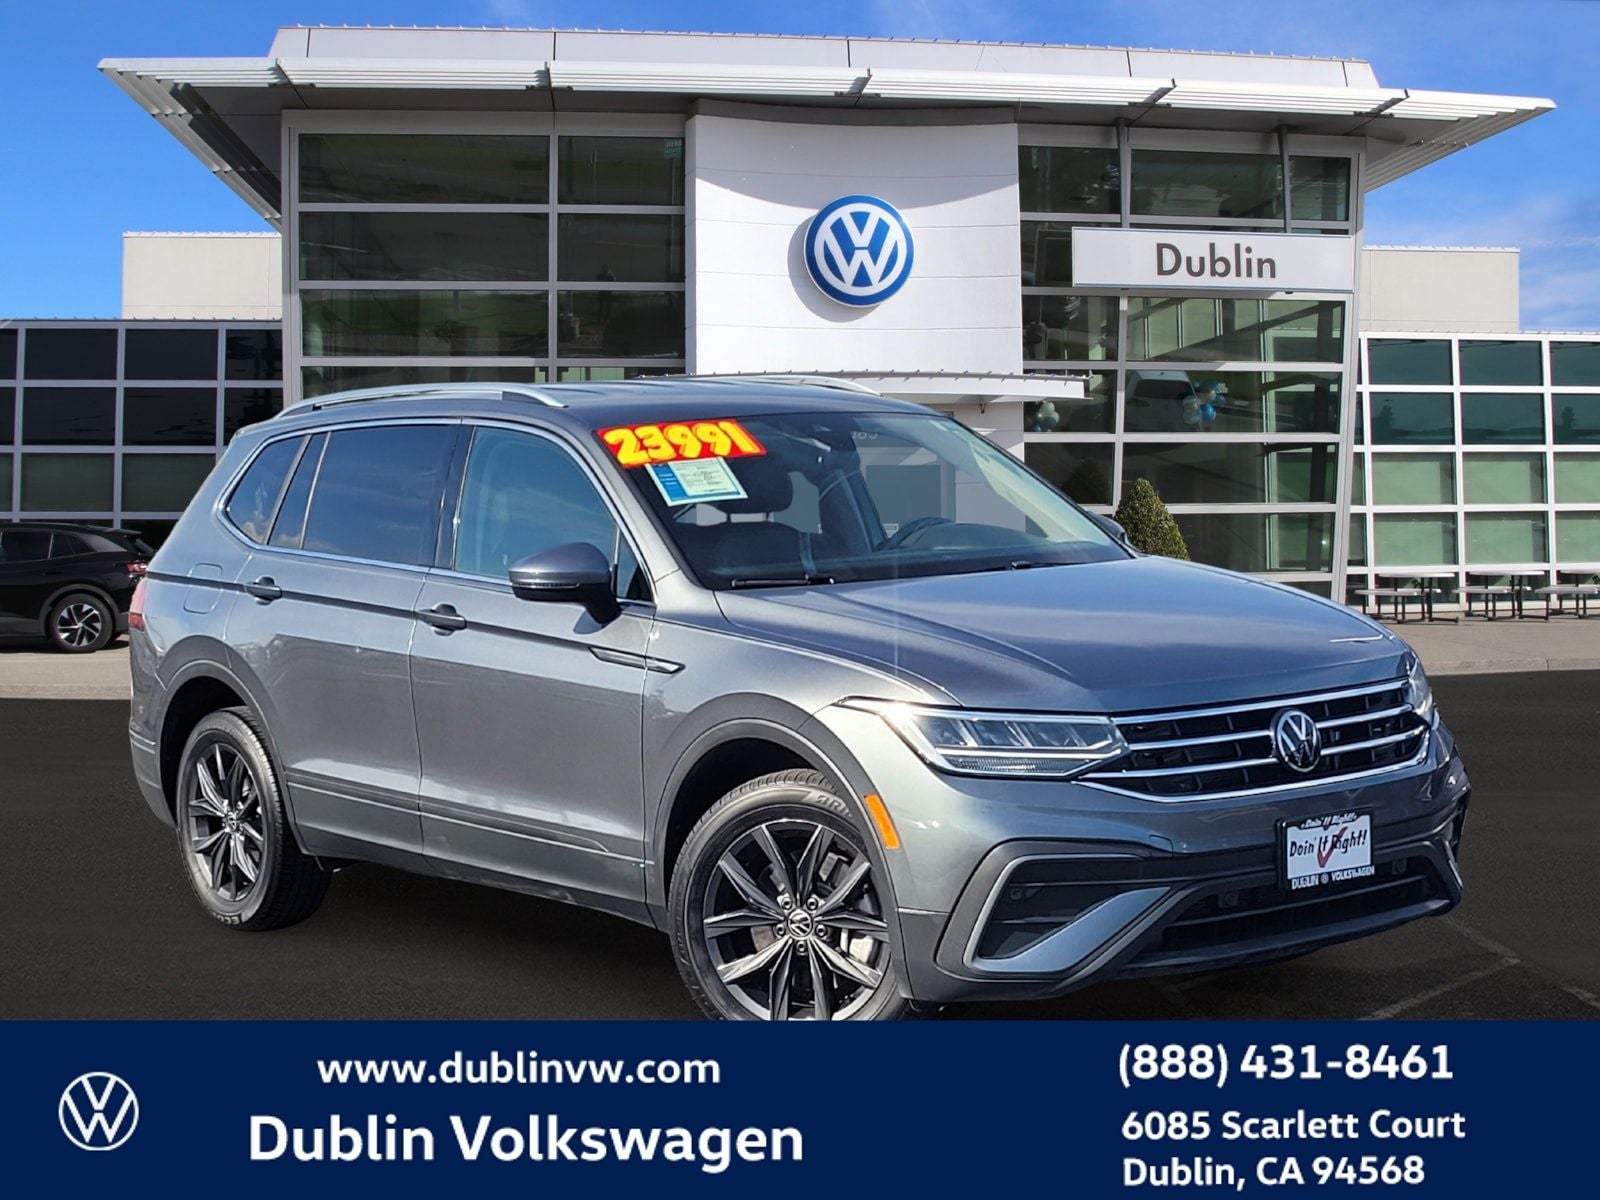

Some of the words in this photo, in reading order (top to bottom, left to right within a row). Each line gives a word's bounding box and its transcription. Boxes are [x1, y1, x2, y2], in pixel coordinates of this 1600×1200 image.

[1156, 242, 1277, 279] Dublin
[604, 421, 760, 463] 23991
[1290, 837, 1317, 857] Doin'
[1292, 875, 1319, 890] DUBLIN
